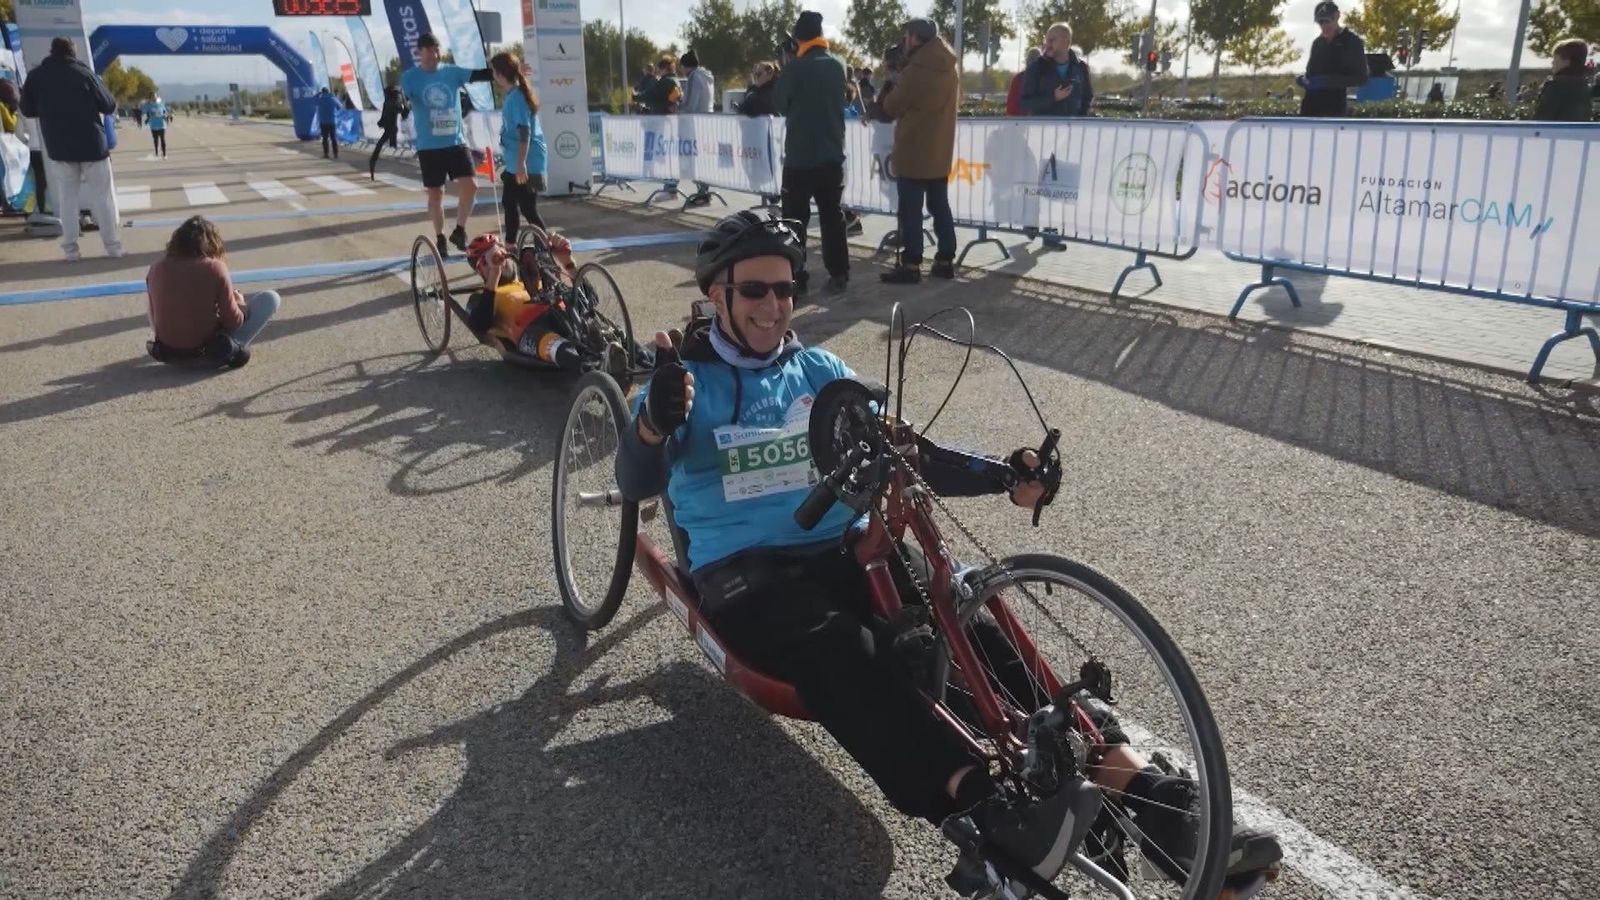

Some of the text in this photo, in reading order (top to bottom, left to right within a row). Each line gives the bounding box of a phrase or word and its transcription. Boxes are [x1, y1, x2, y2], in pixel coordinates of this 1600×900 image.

[199, 27, 236, 36] deporte
[201, 35, 227, 43] salud
[201, 44, 243, 52] felicidad
[555, 104, 576, 114] ACS
[655, 133, 698, 158] Sanitas
[869, 153, 897, 182] AC
[1226, 175, 1321, 205] acciona
[1361, 175, 1443, 191] FUNDACIÓN
[1358, 190, 1533, 229] AltamarCAM
[747, 437, 809, 467] 5056
